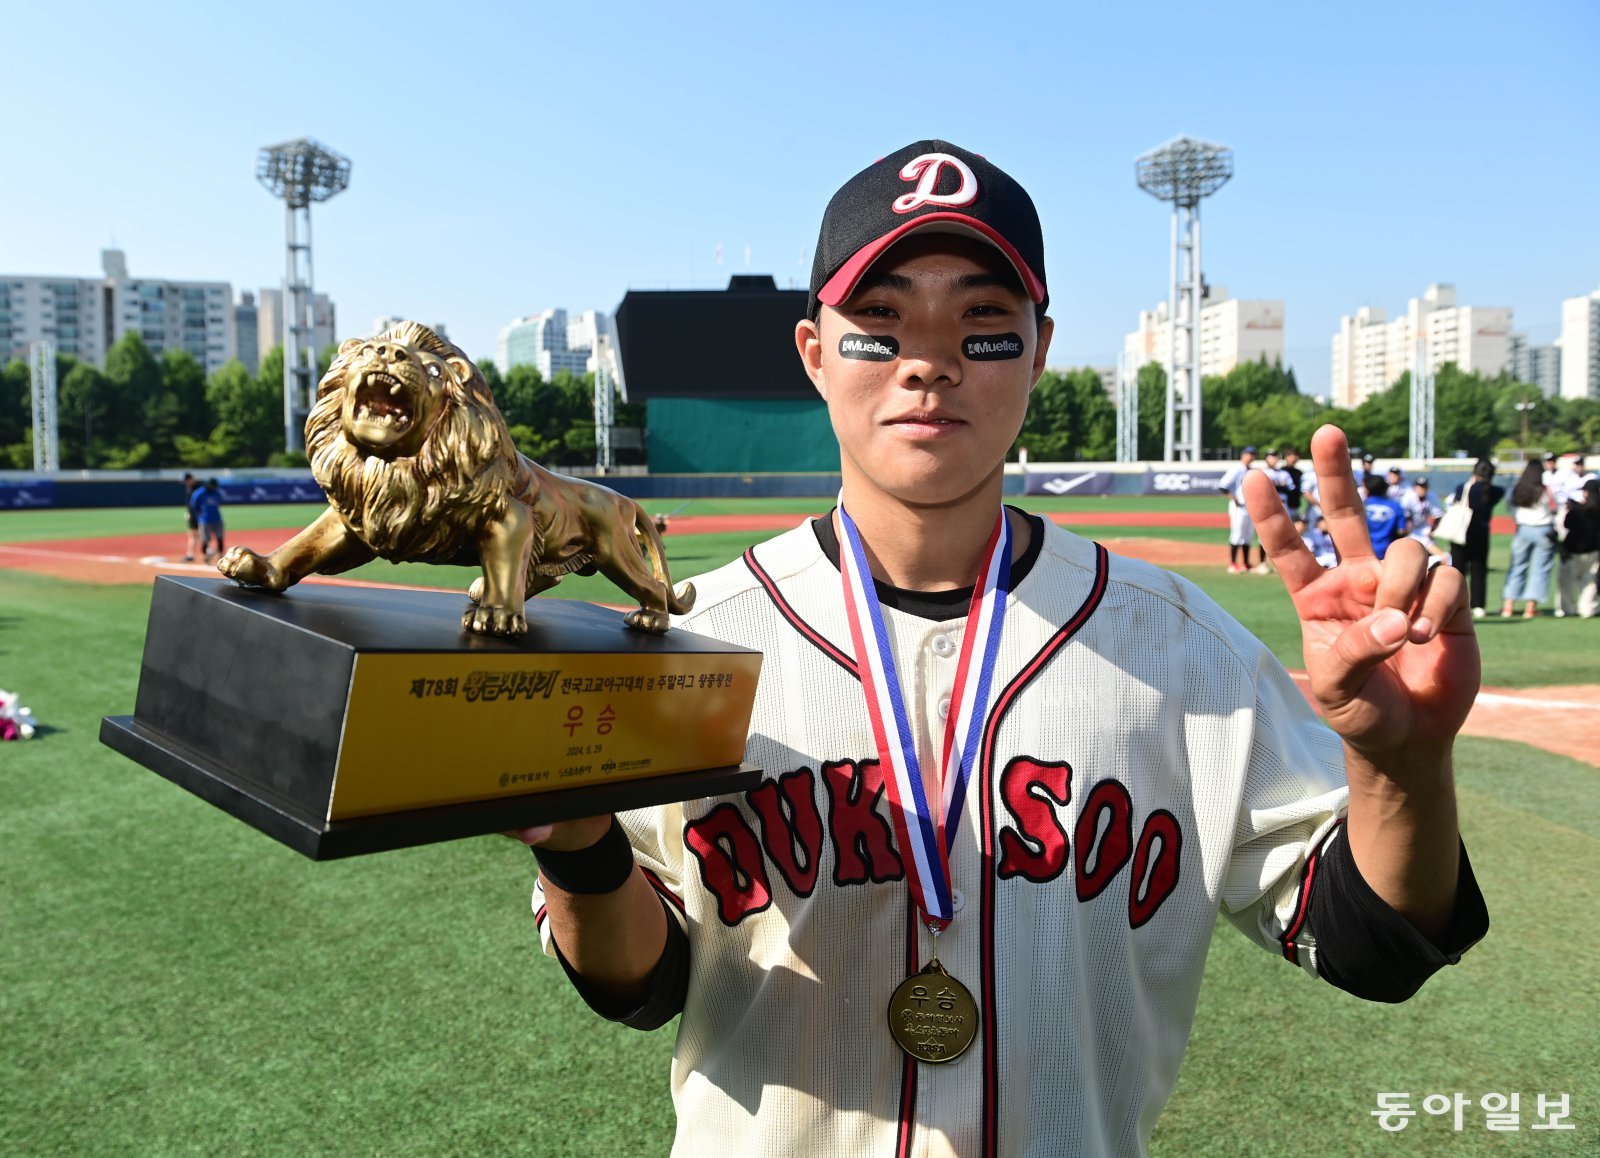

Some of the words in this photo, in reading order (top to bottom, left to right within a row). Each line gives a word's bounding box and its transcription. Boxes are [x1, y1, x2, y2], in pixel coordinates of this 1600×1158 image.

[892, 152, 980, 214] D
[409, 677, 459, 699] 제78회
[462, 670, 562, 703] 황금사자기
[561, 676, 644, 695] 전국고교야구대회
[646, 677, 655, 691] 겸
[657, 674, 695, 691] 주말리그
[698, 673, 733, 689] 왕중왕전
